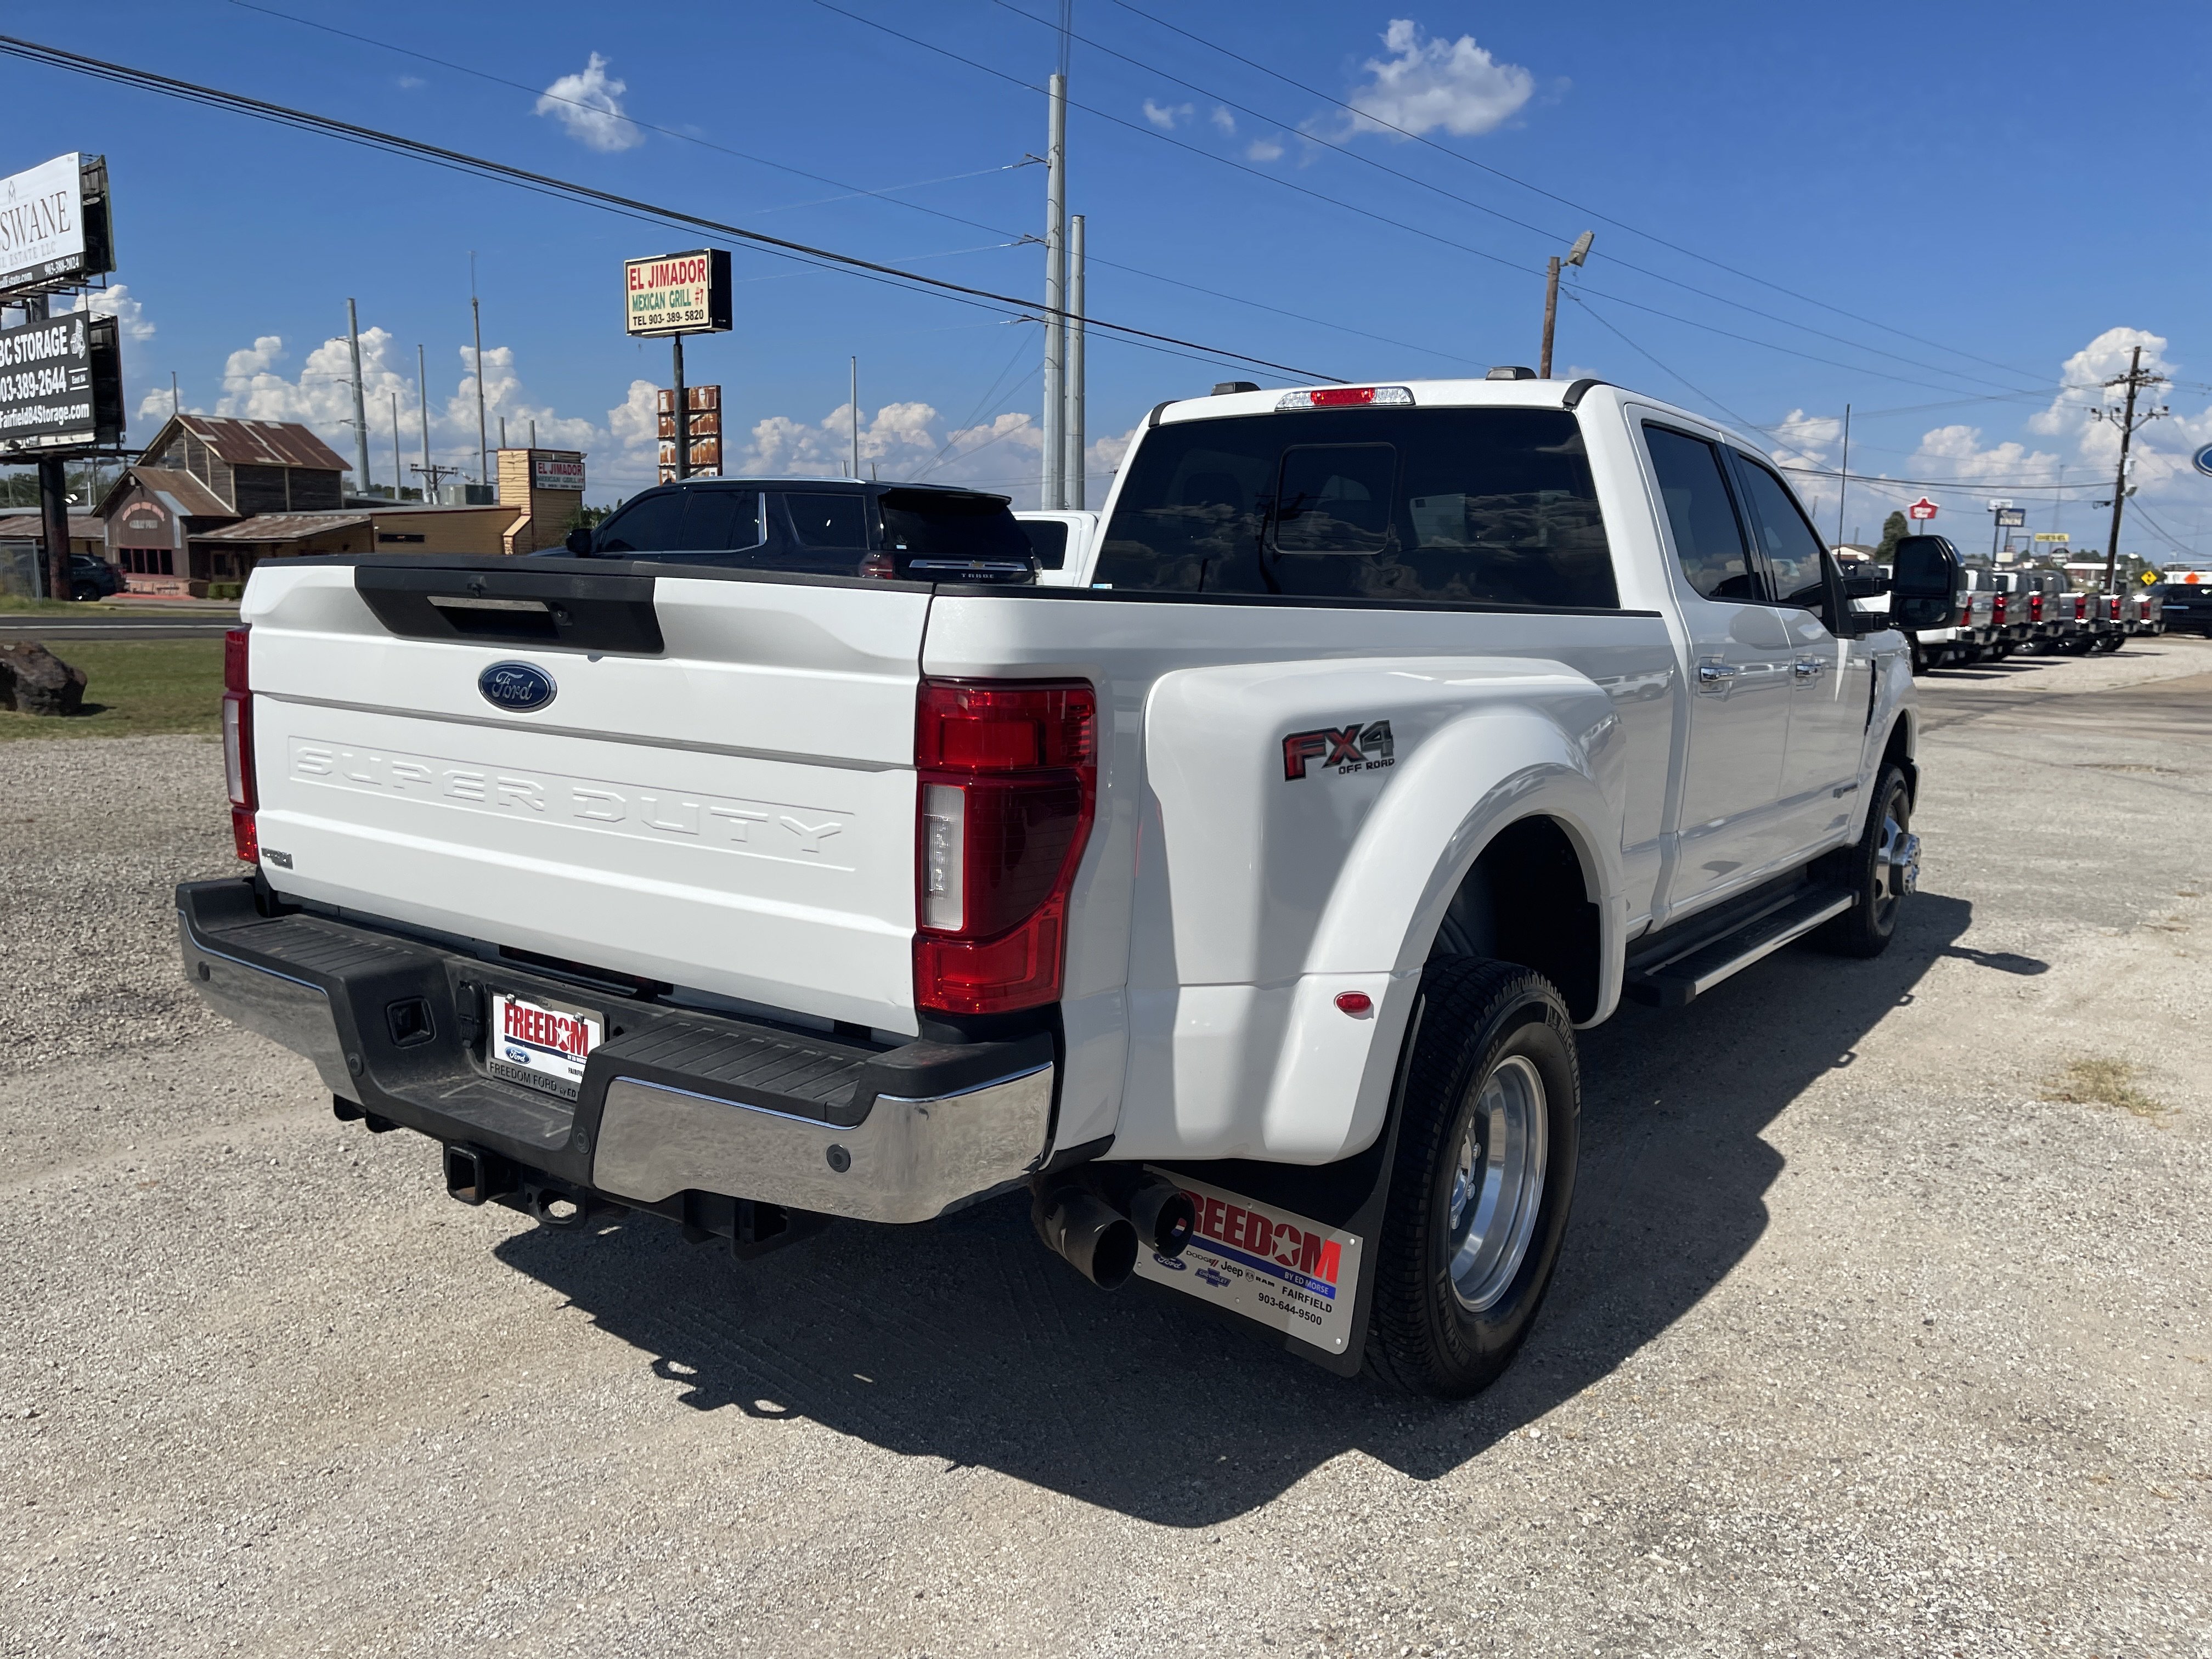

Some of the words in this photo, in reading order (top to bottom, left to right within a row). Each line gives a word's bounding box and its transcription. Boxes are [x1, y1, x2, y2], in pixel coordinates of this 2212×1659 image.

[10, 246, 38, 266] ESTATE
[41, 241, 57, 257] LLC
[630, 267, 644, 291] EL
[648, 258, 706, 289] JIMADOR
[632, 291, 665, 312] MEXICAN
[669, 289, 691, 308] GRILL
[633, 316, 647, 326] TEL
[14, 325, 69, 364] STORAGE
[0, 365, 67, 403] 03-389-2644
[538, 462, 548, 474] EL
[549, 464, 582, 476] JIMADOR
[491, 671, 534, 701] Ford
[1282, 719, 1395, 782] FX4
[1338, 763, 1362, 775] OFF
[1366, 758, 1395, 770] ROAD
[297, 747, 545, 812] SUPER
[573, 787, 842, 853] DUTY
[504, 1002, 589, 1057] FREEDOM
[509, 1049, 526, 1063] Ford
[568, 1067, 584, 1077] FAIRFIE
[1557, 1018, 1581, 1105] MICHELIN
[490, 1062, 531, 1085] FREEDOM
[533, 1074, 557, 1091] FORD
[567, 1088, 576, 1097] ED
[1180, 1188, 1342, 1284] REEDOM
[1186, 1250, 1215, 1264] DODGE
[1221, 1261, 1244, 1278] Jeep
[1255, 1276, 1275, 1288] RAM
[1199, 1270, 1228, 1285] CHEVROLET
[1284, 1271, 1294, 1281] BY
[1295, 1275, 1304, 1285] ED
[1305, 1279, 1329, 1295] MORSE
[1258, 1292, 1322, 1325] 903-644-9500
[1282, 1285, 1333, 1313] FAIRFIELD
[1437, 1282, 1471, 1367] MICHELIN
